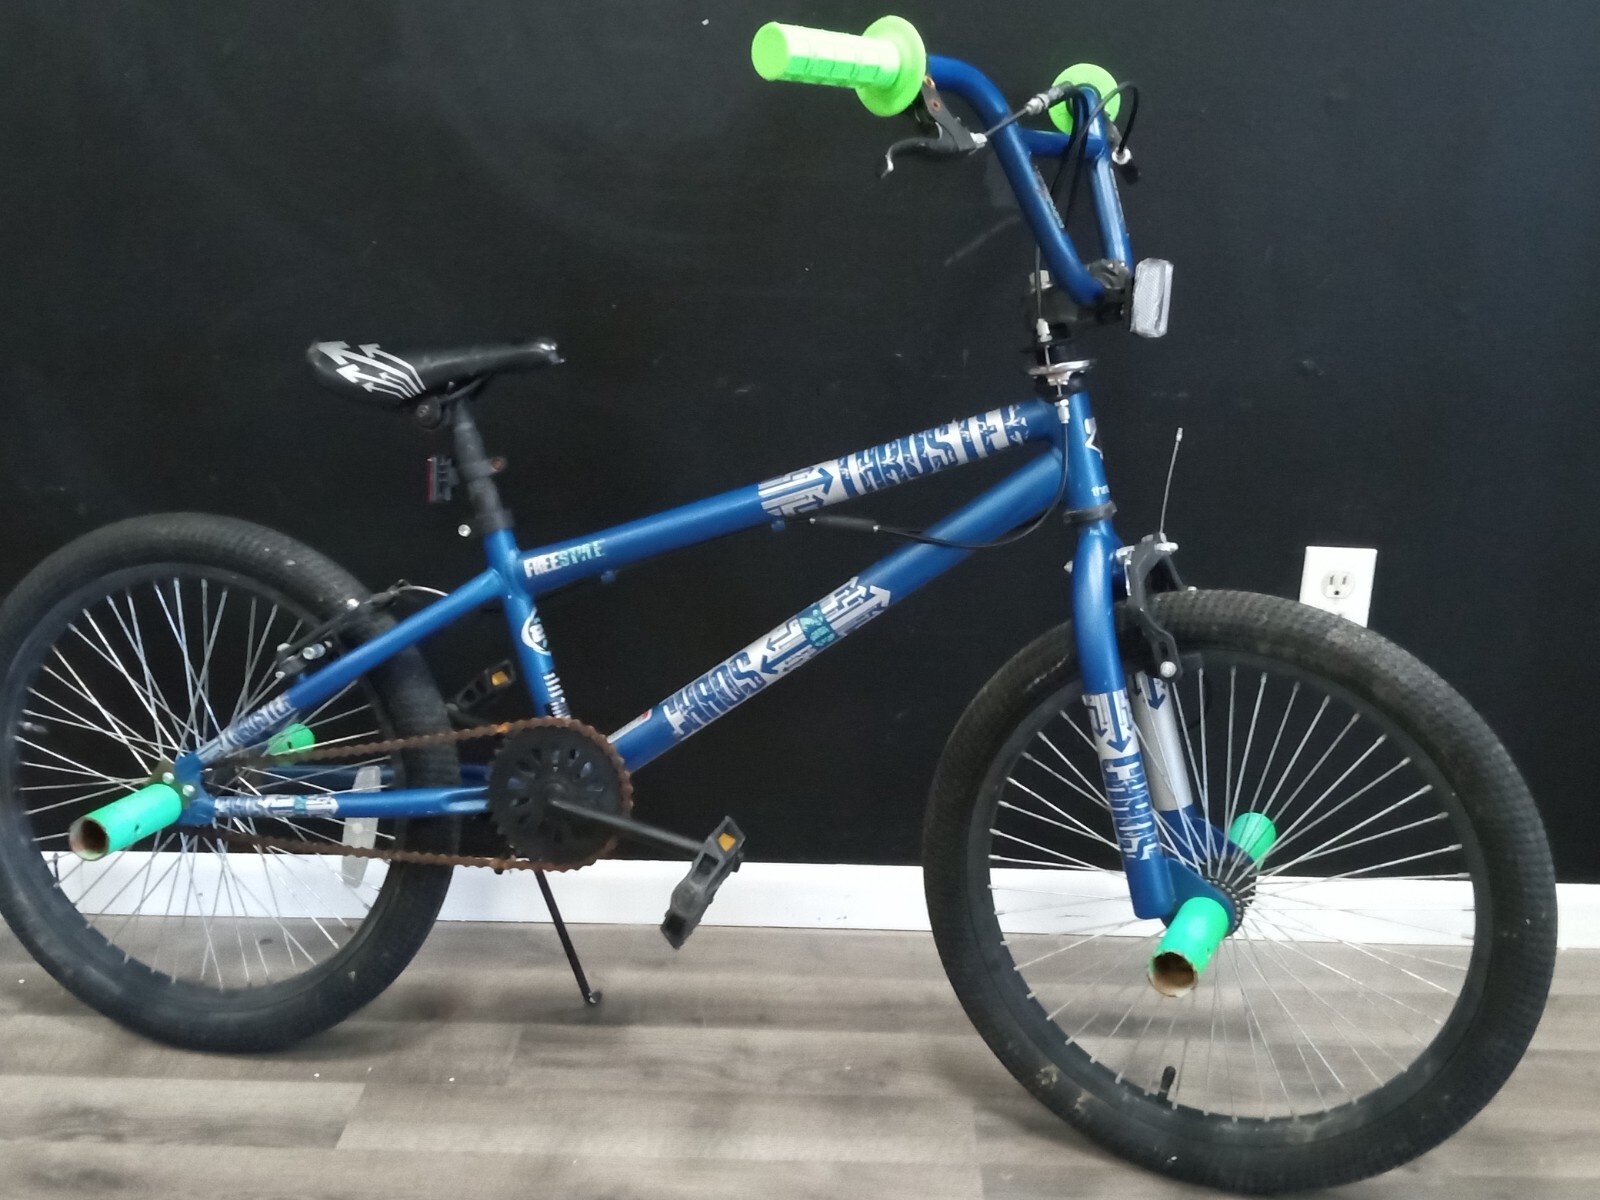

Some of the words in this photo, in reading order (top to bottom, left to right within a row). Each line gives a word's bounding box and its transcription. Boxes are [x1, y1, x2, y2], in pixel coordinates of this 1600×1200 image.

[523, 539, 606, 578] FREESTYLE
[662, 651, 766, 736] CHAOS
[1102, 755, 1158, 861] CHAOS
